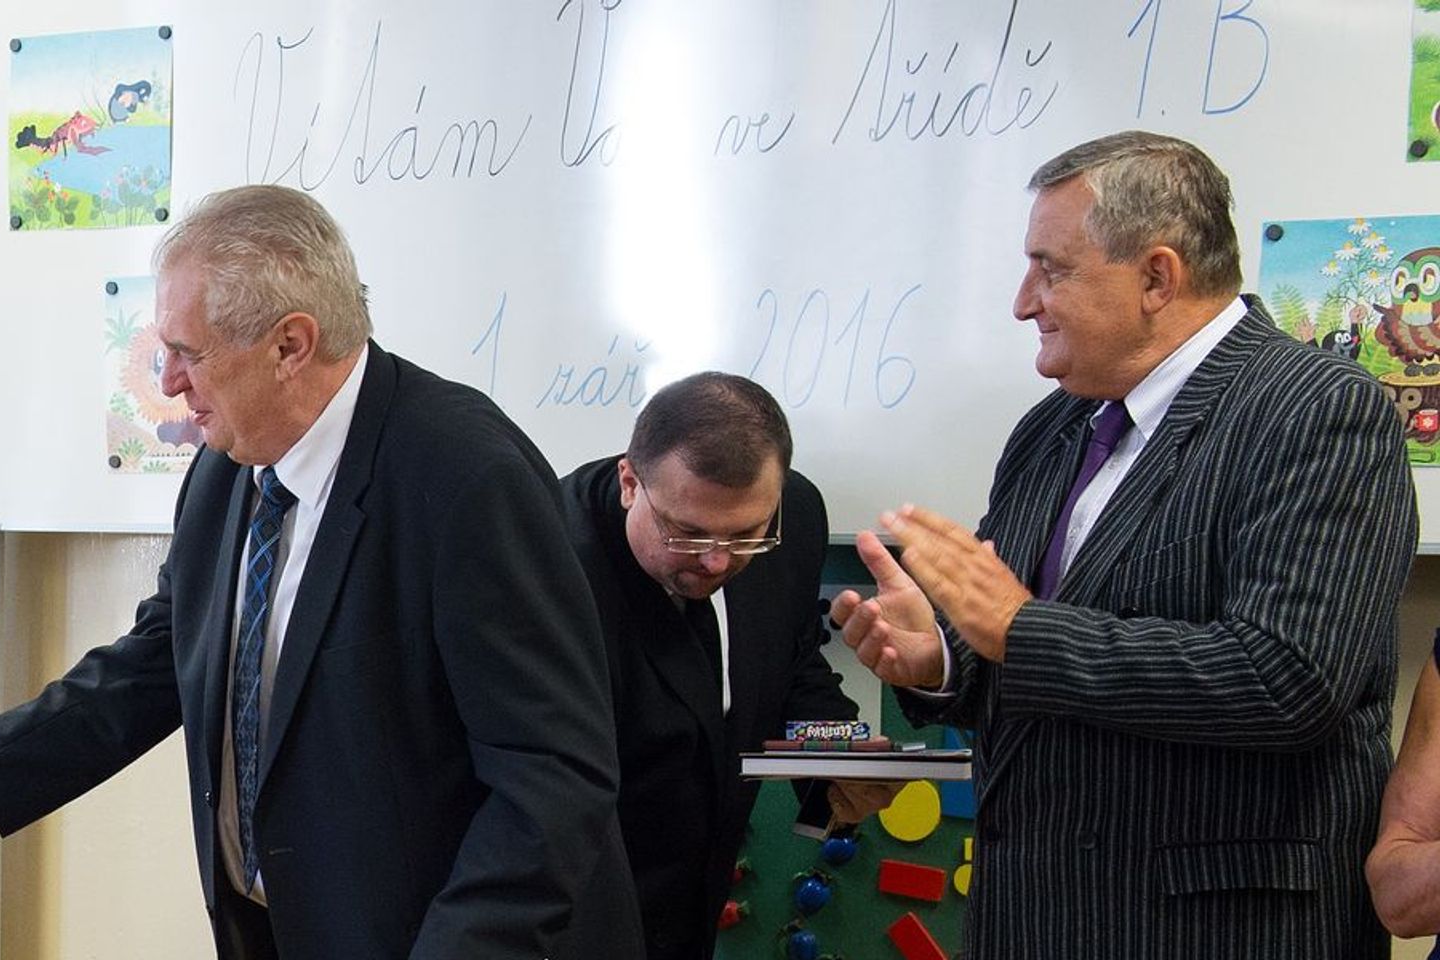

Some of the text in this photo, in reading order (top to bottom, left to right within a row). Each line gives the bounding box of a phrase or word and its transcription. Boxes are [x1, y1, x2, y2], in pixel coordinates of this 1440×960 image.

[233, 20, 532, 192] Vítám
[714, 112, 795, 156] ve
[1201, 0, 1270, 115] B
[536, 334, 653, 409] zář
[747, 284, 922, 410] 2016
